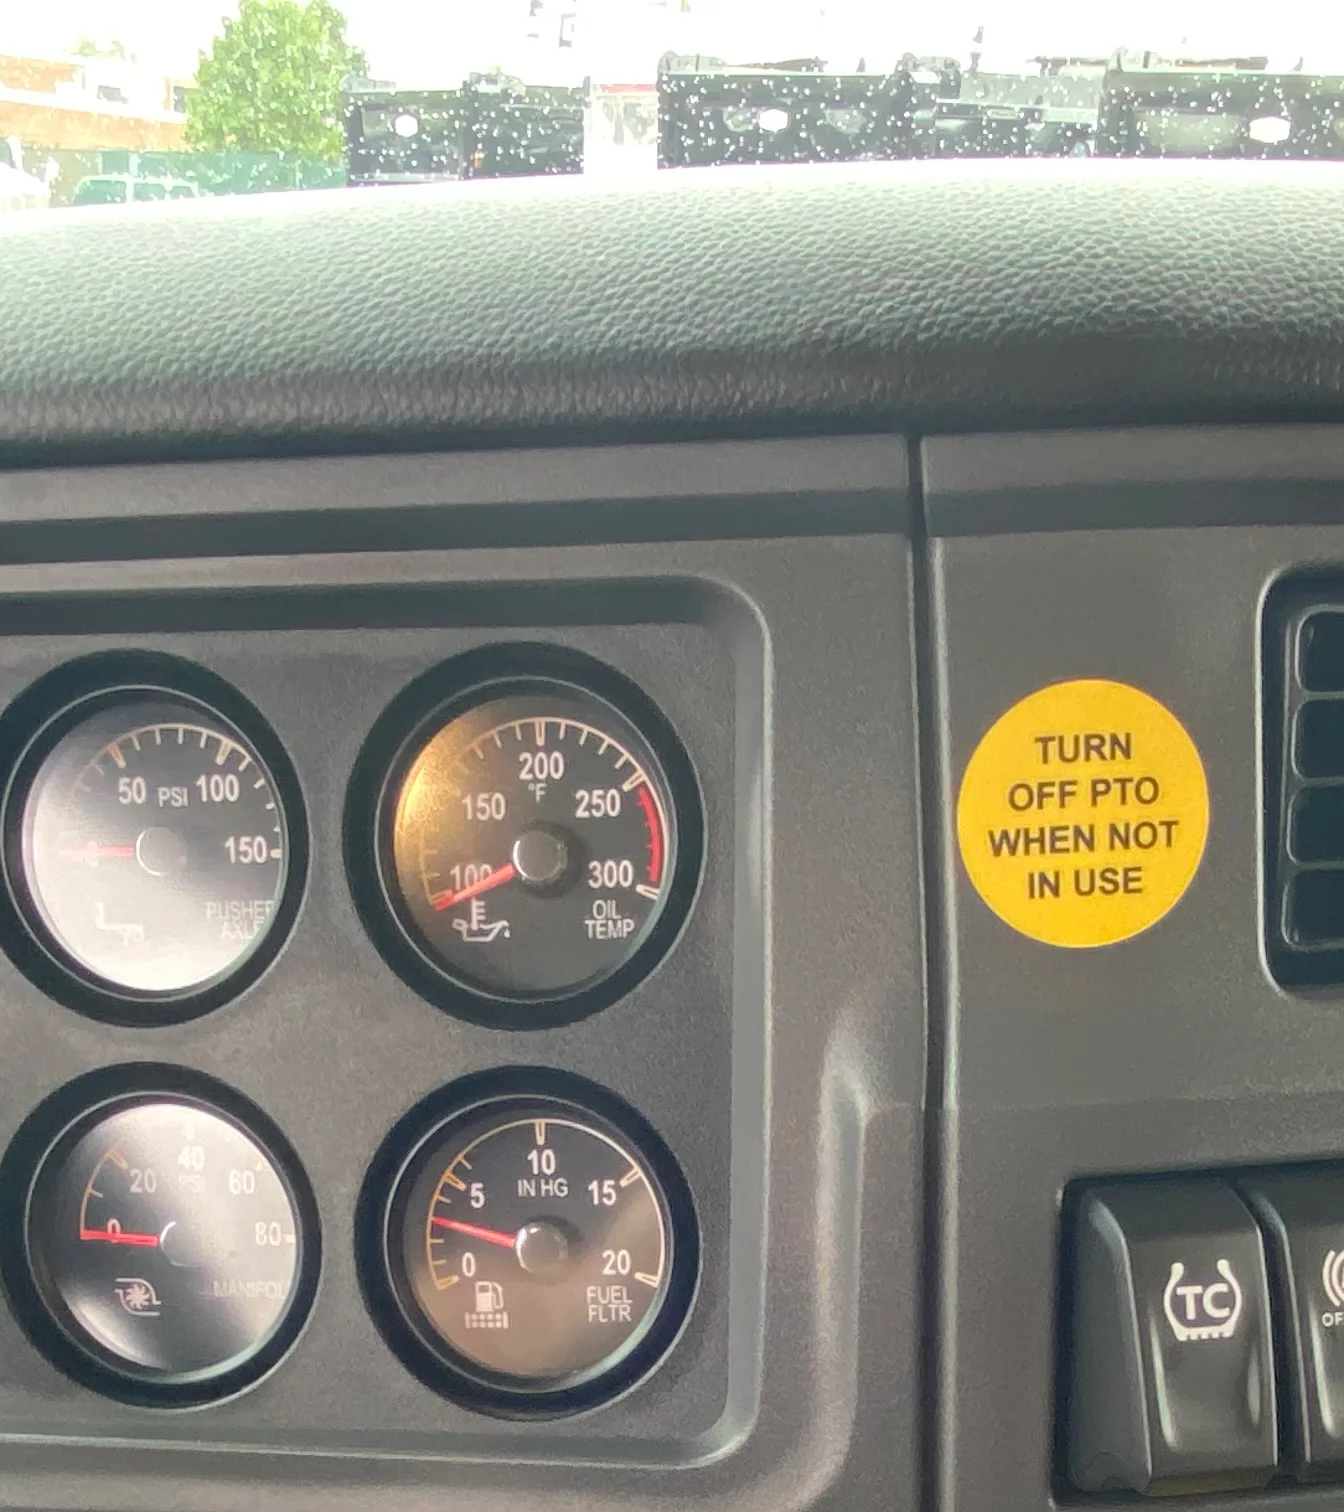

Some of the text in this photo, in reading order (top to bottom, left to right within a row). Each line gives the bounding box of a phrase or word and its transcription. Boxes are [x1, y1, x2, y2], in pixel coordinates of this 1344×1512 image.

[1035, 732, 1132, 765] TURN
[519, 752, 564, 780] 200
[118, 776, 146, 804] 50
[158, 787, 188, 807] PSI
[196, 774, 240, 802] 100
[1008, 776, 1160, 812] OFF PTO
[462, 793, 506, 820] 150
[575, 789, 621, 818] 250
[224, 836, 267, 863] 150
[988, 819, 1180, 857] WHEN NOT
[450, 864, 493, 890] 100
[588, 860, 633, 888] 300
[1027, 866, 1144, 900] IN USE
[592, 900, 621, 920] OIL
[585, 920, 635, 939] TEMP
[177, 1145, 205, 1170] 40
[527, 1149, 556, 1175] 10
[129, 1168, 157, 1193] 20
[228, 1170, 255, 1195] 60
[517, 1178, 569, 1198] IN HG
[588, 1180, 617, 1206] 15
[470, 1182, 485, 1208] 5
[254, 1221, 283, 1247] 80
[462, 1252, 476, 1277] 0
[602, 1250, 632, 1275] 20
[212, 1279, 286, 1299] MANIFOL
[587, 1285, 633, 1304] FUEL
[1176, 1283, 1231, 1321] TC
[587, 1304, 632, 1323] FLTR
